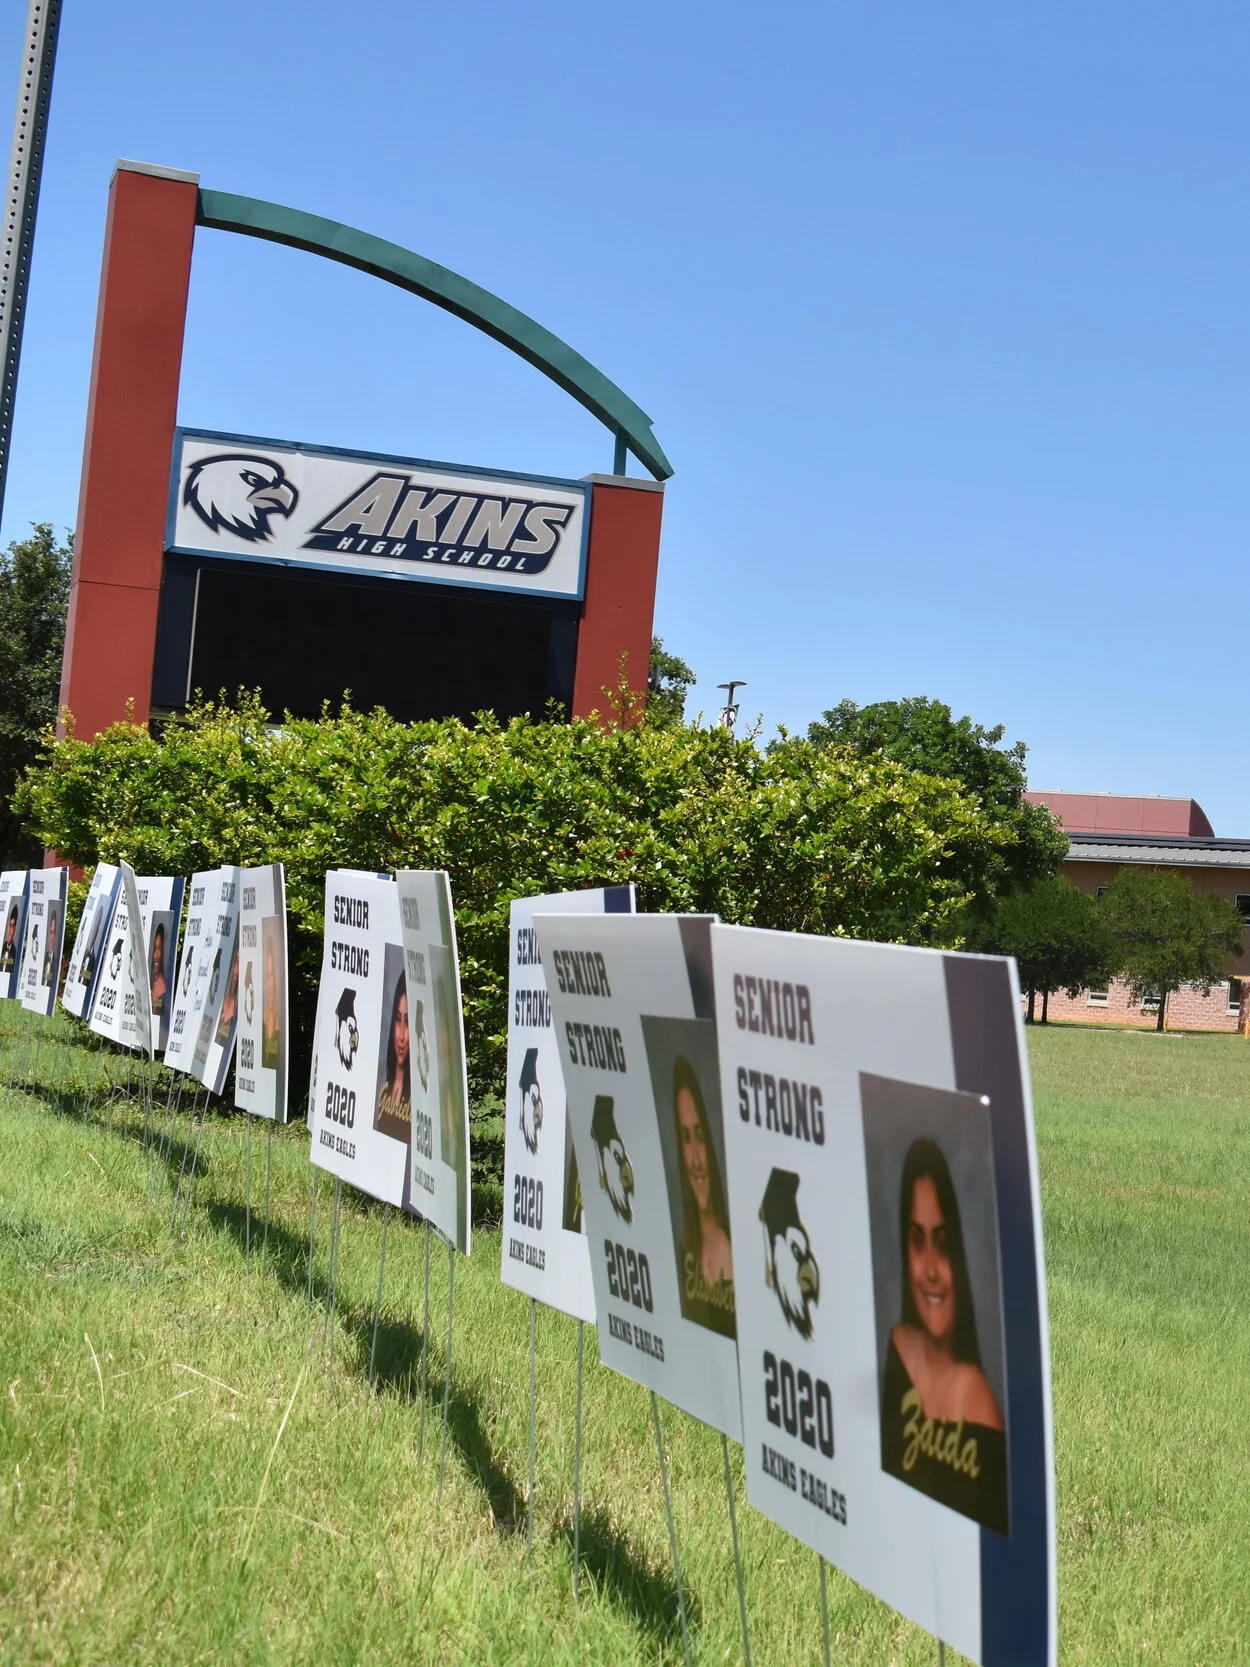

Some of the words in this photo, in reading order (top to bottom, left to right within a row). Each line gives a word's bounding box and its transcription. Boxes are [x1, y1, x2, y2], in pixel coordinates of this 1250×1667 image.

[318, 475, 570, 555] AKINS
[336, 536, 409, 557] HIGH
[422, 546, 526, 571] SCHOOL
[333, 894, 369, 930] SENIOR
[331, 941, 369, 978] STRONG
[517, 928, 542, 966] SENI
[553, 950, 612, 998] SENIOR
[515, 989, 551, 1028] STRONG
[733, 972, 815, 1046] SENIOR
[565, 1021, 627, 1074] STRONG
[325, 1081, 356, 1129] 2020
[737, 1065, 826, 1147] STRONG
[320, 1128, 335, 1150] AKINS
[335, 1137, 356, 1160] EAGLES
[416, 1109, 433, 1160] 2020
[513, 1173, 544, 1231] 2020
[509, 1237, 524, 1263] AKINS
[525, 1245, 546, 1271] EAGLES
[604, 1238, 654, 1314] 2020
[608, 1312, 634, 1347] AKINS
[633, 1324, 665, 1363] EAGLES
[763, 1349, 835, 1461] 2020
[901, 1387, 982, 1480] Zaida
[761, 1443, 797, 1493] AKINS
[800, 1467, 848, 1527] EAGLES
